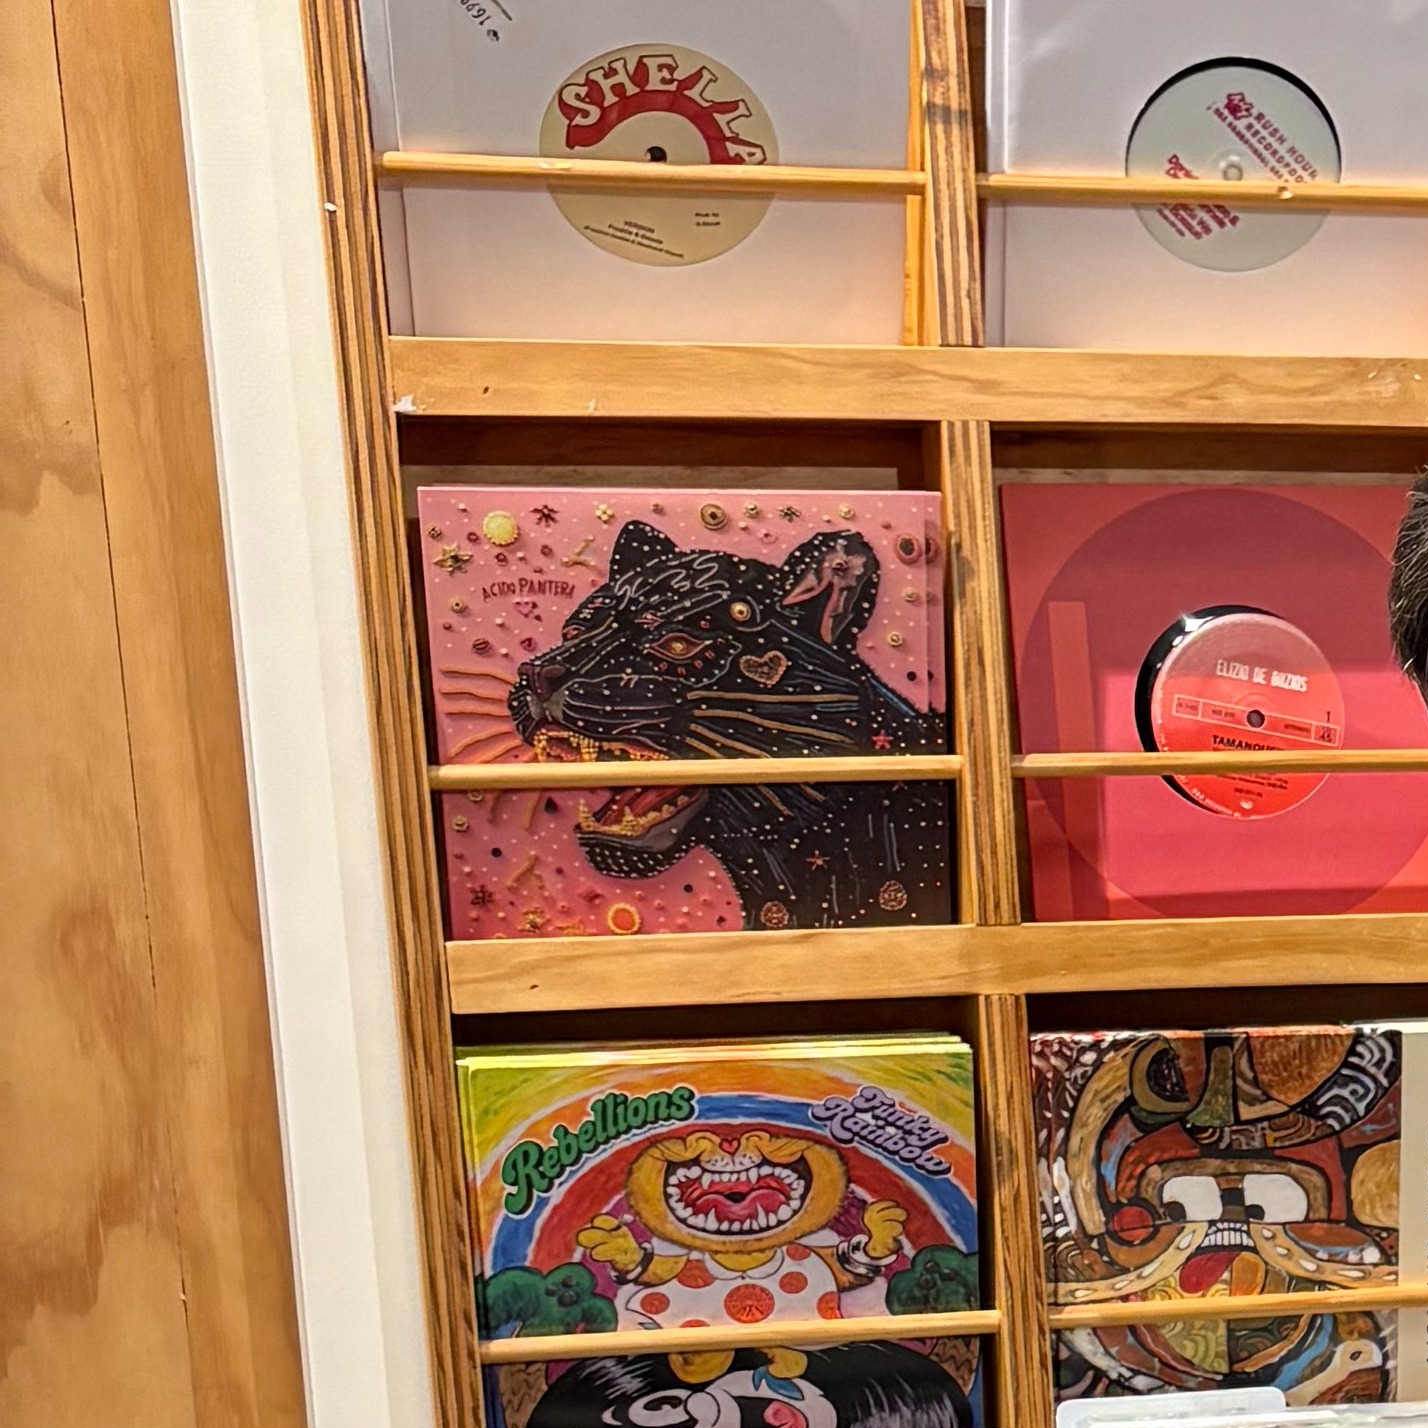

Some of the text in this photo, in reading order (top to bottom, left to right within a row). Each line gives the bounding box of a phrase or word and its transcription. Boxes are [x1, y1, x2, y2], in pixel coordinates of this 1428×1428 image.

[1252, 666, 1268, 685] DE
[501, 1085, 697, 1216] Rebellions
[812, 1097, 953, 1176] Rainbow
[852, 1085, 951, 1147] Funky
